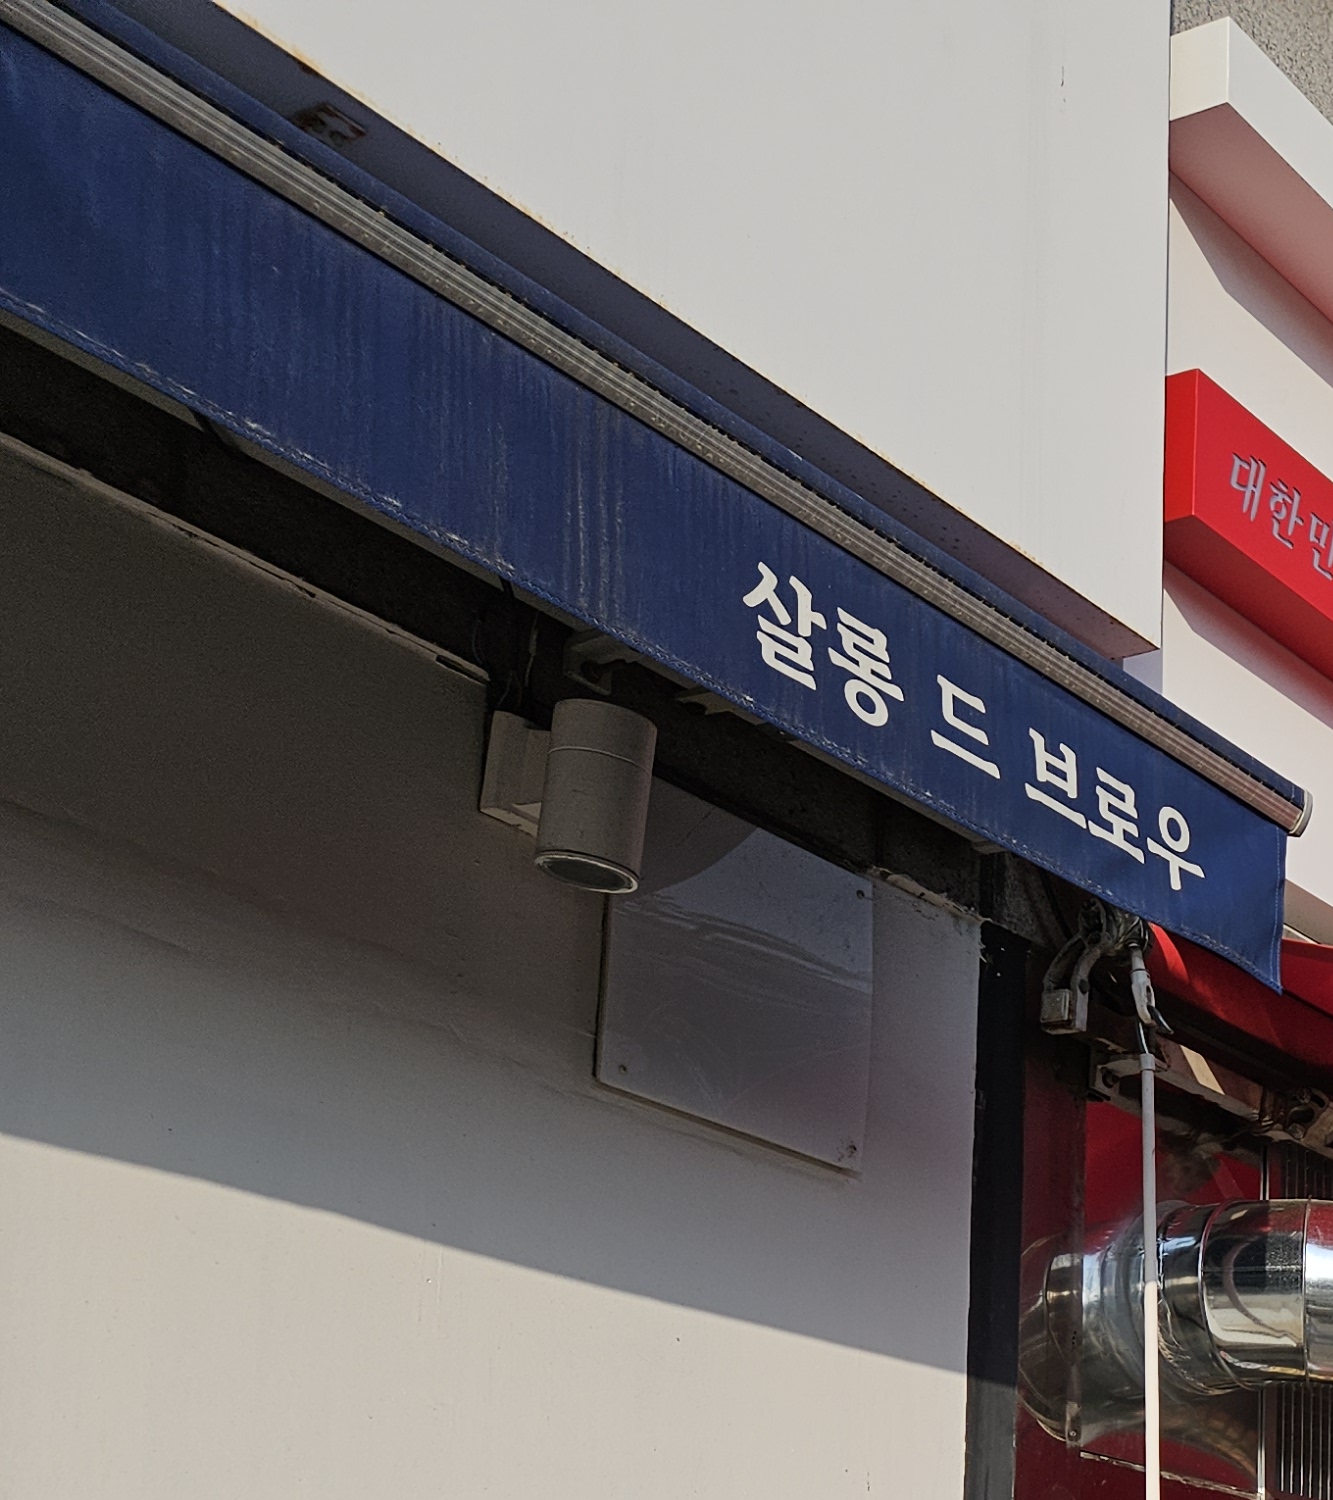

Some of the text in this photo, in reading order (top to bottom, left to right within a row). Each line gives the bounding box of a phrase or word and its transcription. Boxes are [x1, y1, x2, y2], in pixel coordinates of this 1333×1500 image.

[743, 562, 1206, 891] 살롱 드 브로우
